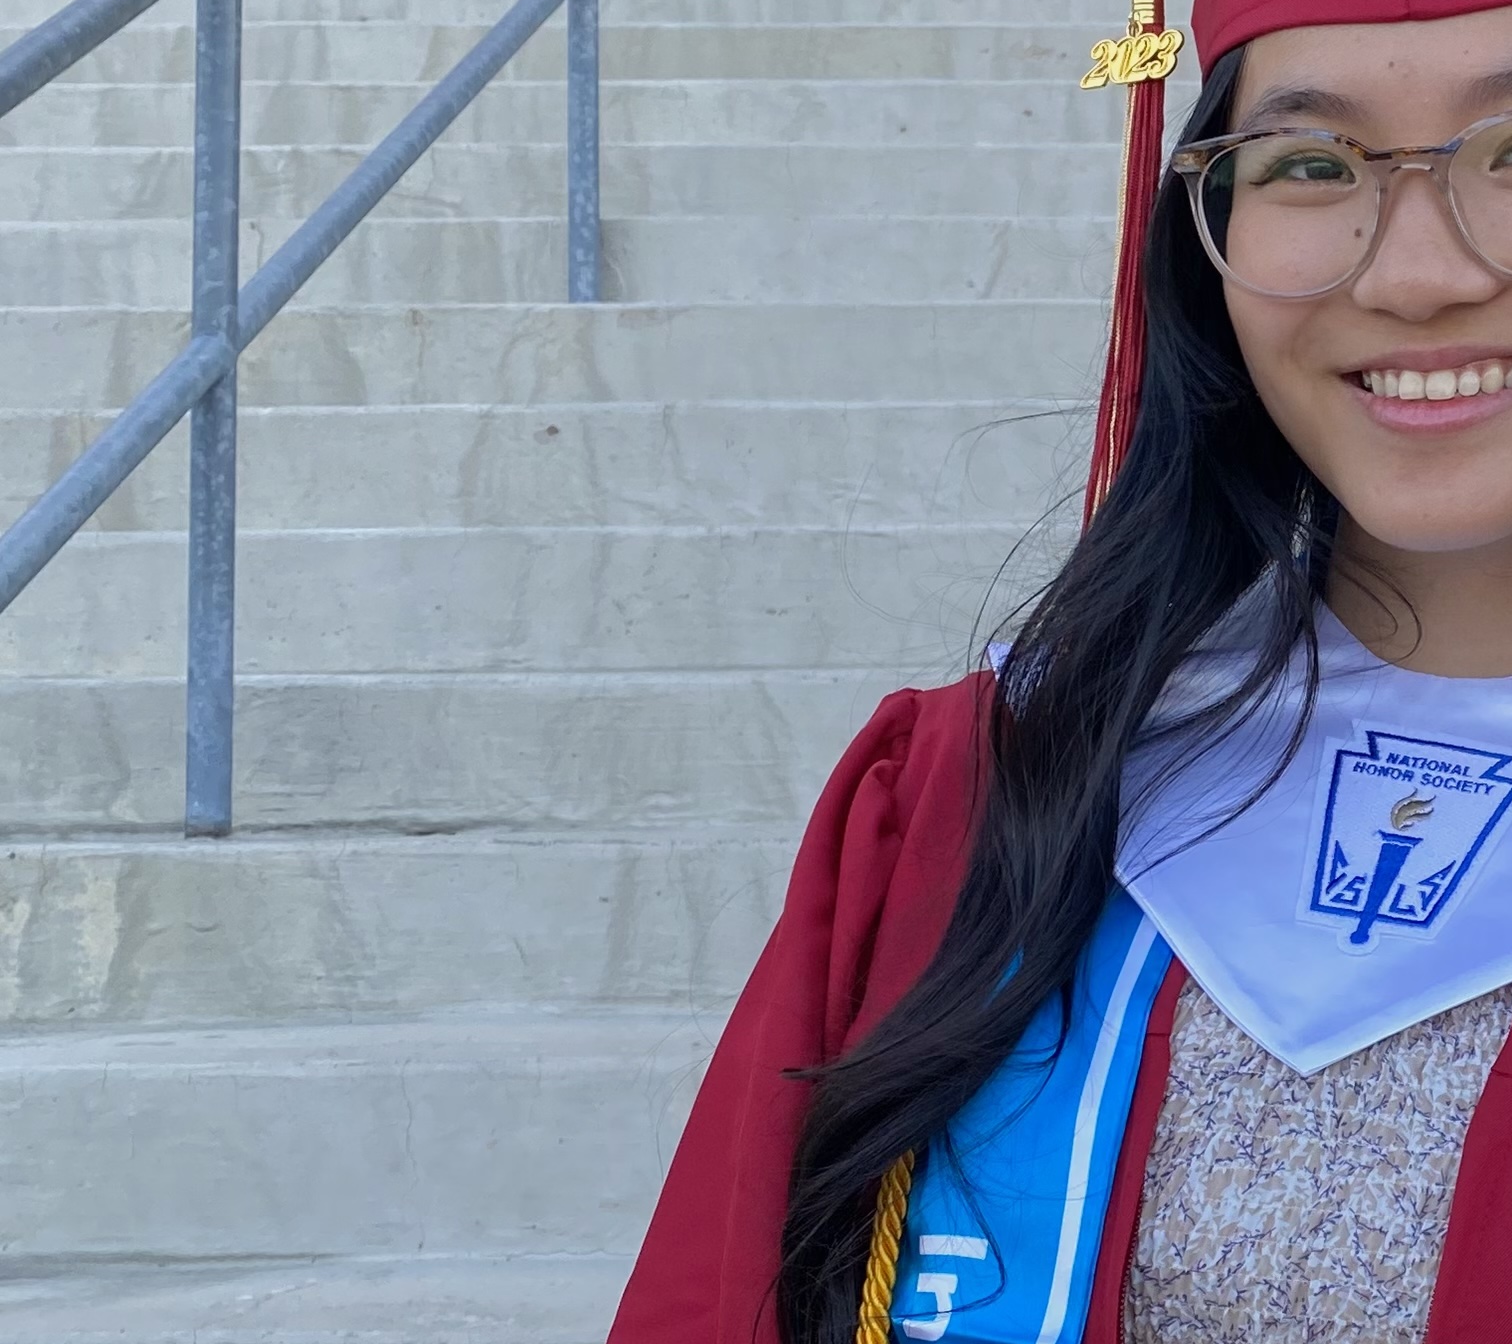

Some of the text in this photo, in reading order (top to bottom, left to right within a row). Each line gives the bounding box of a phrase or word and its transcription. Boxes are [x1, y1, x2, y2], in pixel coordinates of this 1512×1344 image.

[1080, 29, 1184, 89] 2023
[1352, 761, 1496, 795] HONOR SOCIETY
[1386, 752, 1472, 777] NATIONAL
